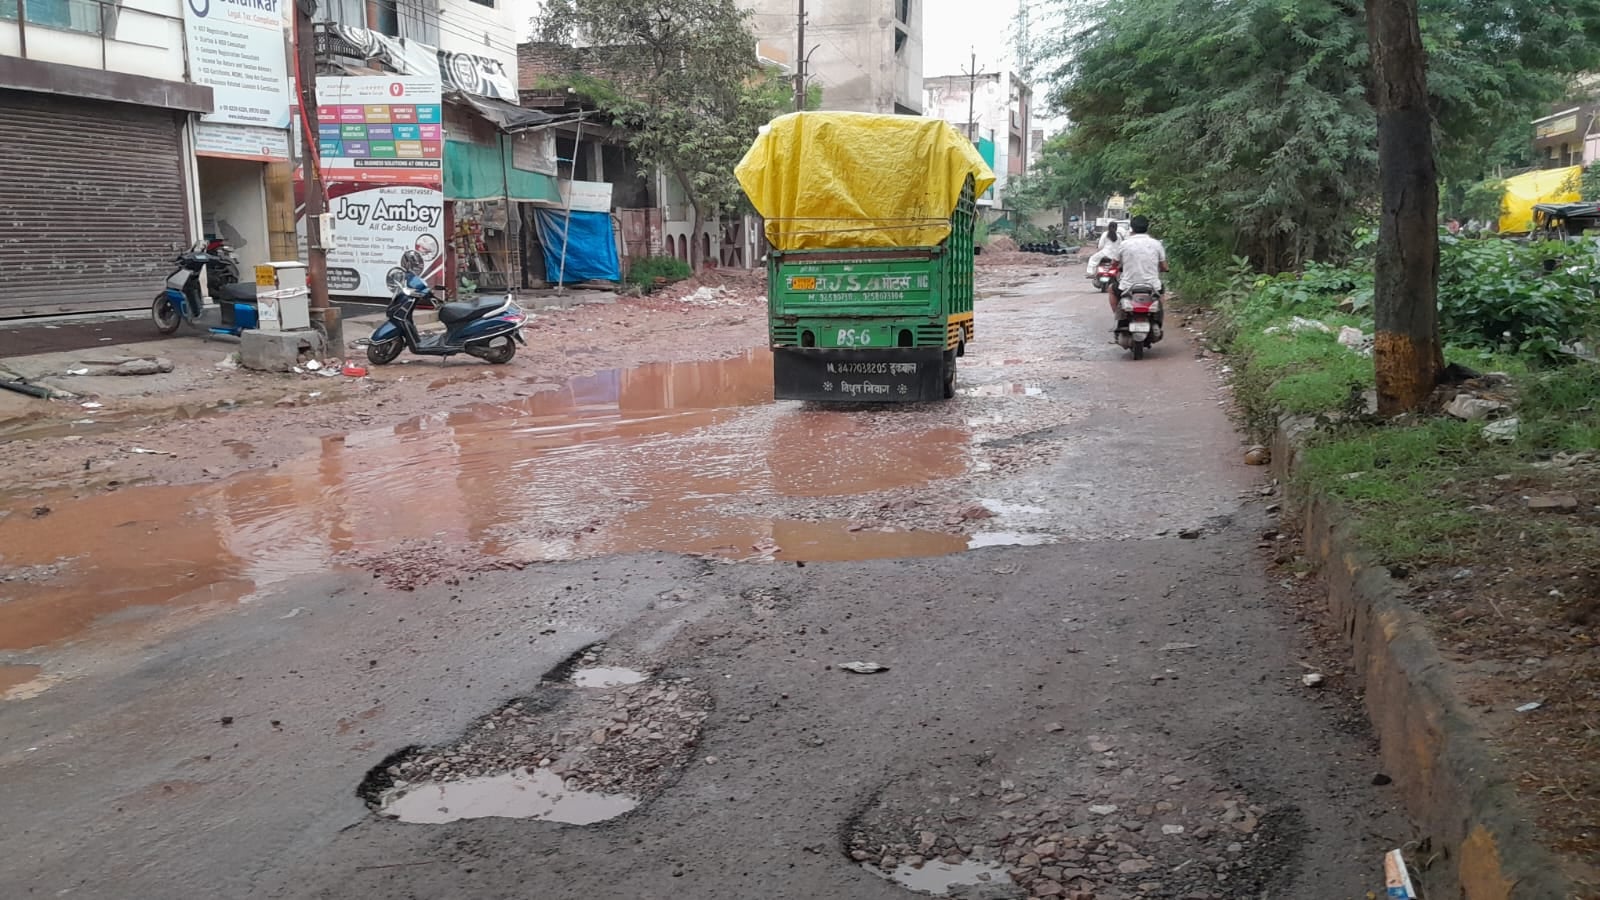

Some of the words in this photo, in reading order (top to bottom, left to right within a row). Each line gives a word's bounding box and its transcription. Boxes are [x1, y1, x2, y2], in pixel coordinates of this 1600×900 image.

[337, 197, 370, 225] Jay
[372, 197, 442, 228] Ambey
[369, 223, 380, 231] All
[396, 224, 428, 232] Solution
[836, 328, 871, 346] BS-6
